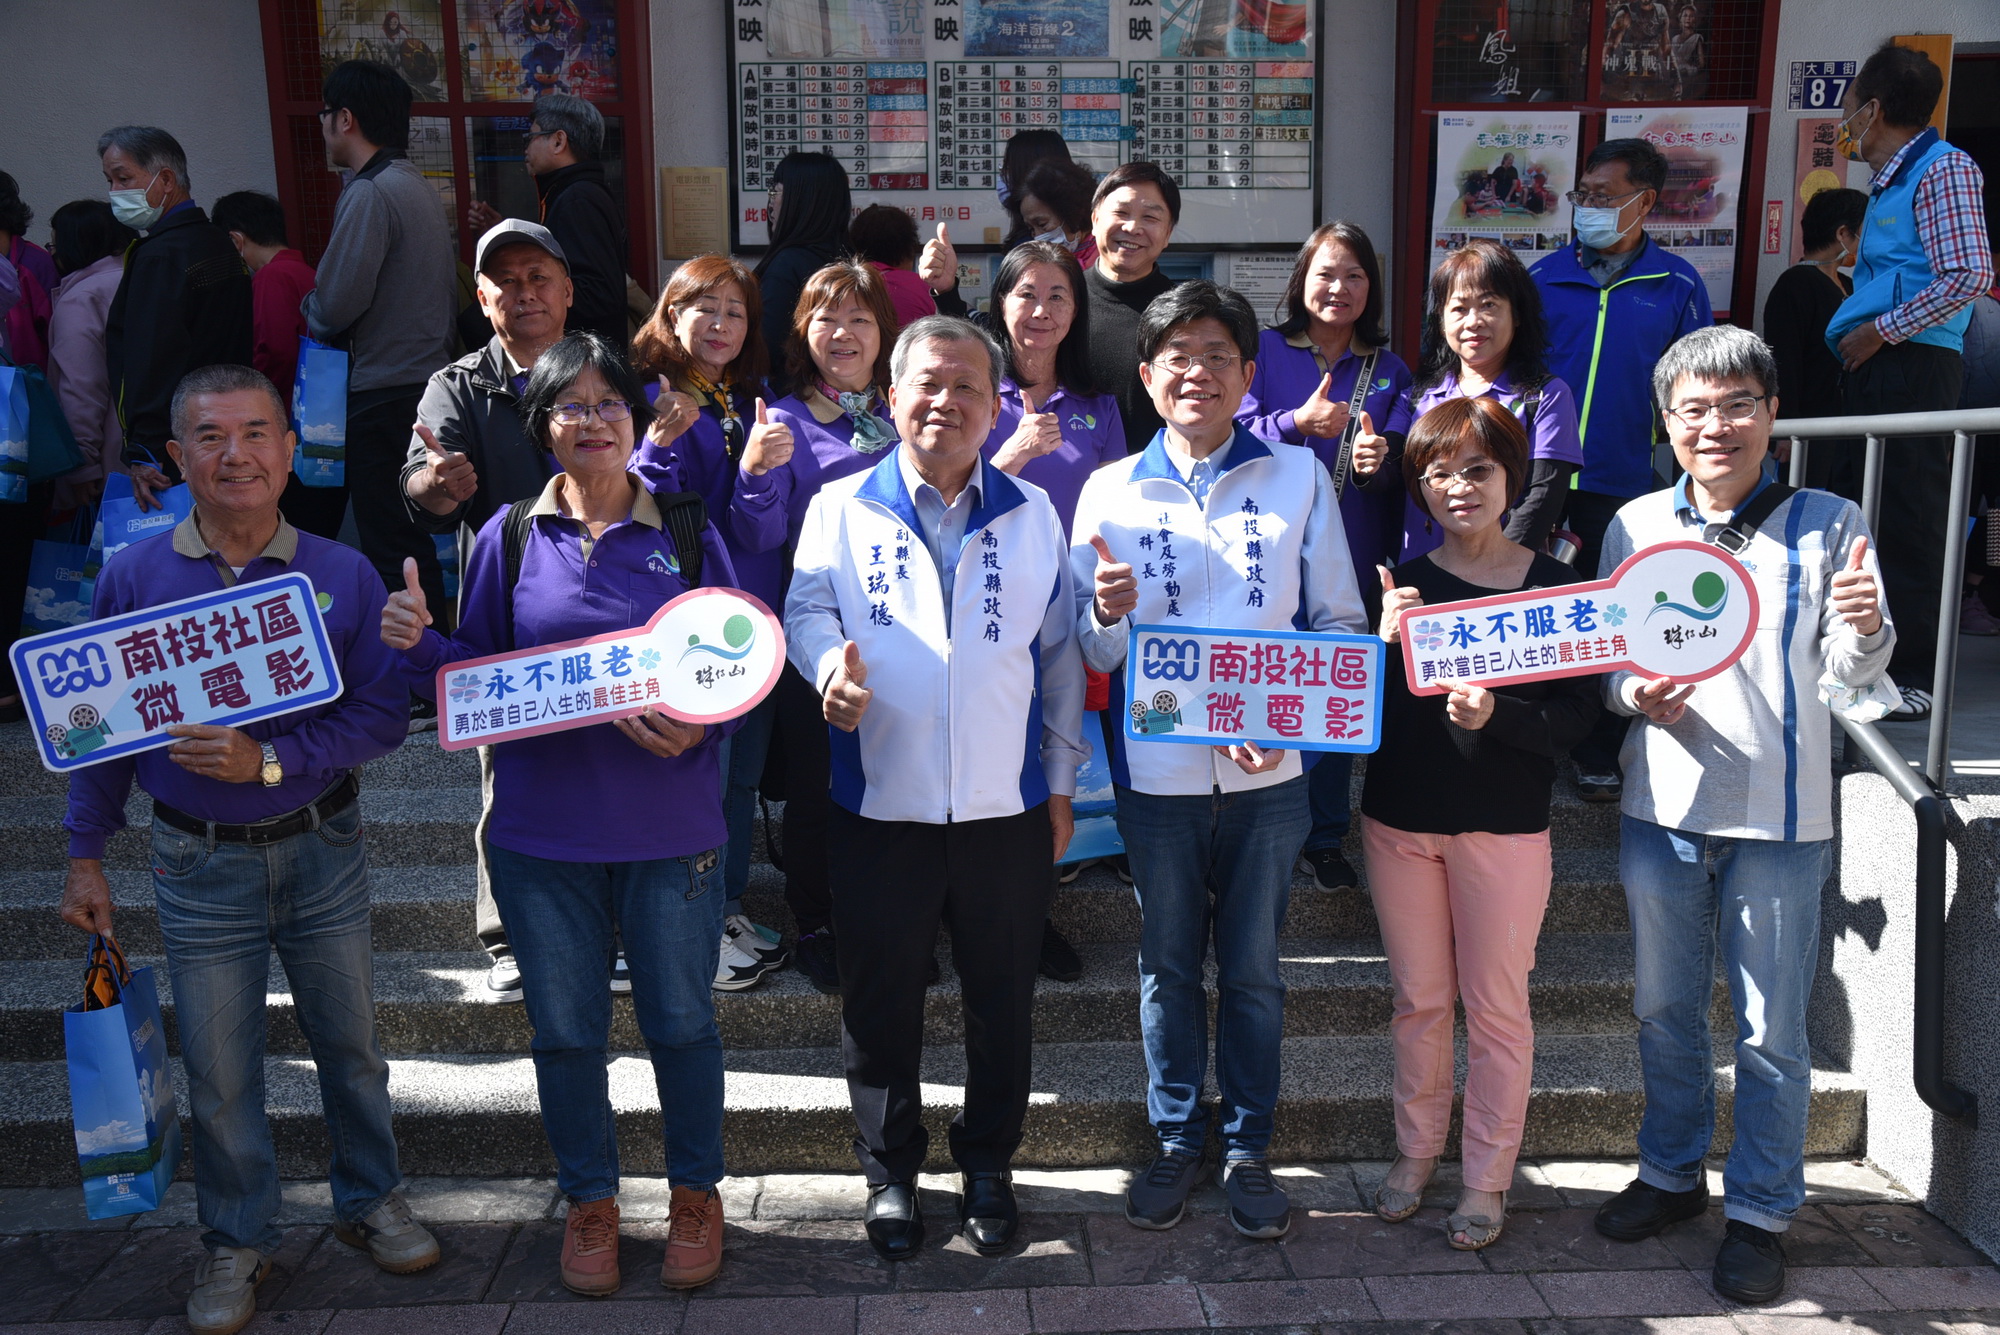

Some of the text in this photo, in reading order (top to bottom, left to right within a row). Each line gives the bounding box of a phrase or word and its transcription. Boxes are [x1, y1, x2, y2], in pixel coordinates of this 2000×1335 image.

[1015, 65, 1026, 76] 點
[1046, 65, 1058, 76] 分
[1791, 62, 1802, 85] 南投市
[1805, 62, 1855, 75] 大同街
[762, 82, 797, 93] 第二場
[958, 81, 992, 92] 第二場
[1151, 81, 1184, 92] 第二場
[1810, 78, 1847, 107] 87
[763, 98, 797, 109] 第三場
[958, 97, 992, 108] 第三場
[1151, 97, 1184, 108] 第三場
[763, 114, 798, 125] 第四場
[958, 113, 992, 124] 第四場
[1151, 113, 1184, 124] 第四場
[764, 130, 798, 141] 第五場
[958, 129, 992, 140] 第五場
[1151, 129, 1184, 140] 第五場
[854, 145, 865, 156] 分
[958, 145, 992, 155] 第六場
[1151, 145, 1250, 155] 第六場 點 分
[855, 162, 865, 172] 分
[959, 160, 993, 171] 第七場
[1207, 160, 1218, 171] 點
[1239, 160, 1250, 171] 分
[855, 177, 865, 188] 分
[1207, 176, 1218, 186] 點
[1239, 176, 1250, 186] 分
[894, 528, 910, 580] 副縣長
[1138, 534, 1158, 579] 科長
[1241, 497, 1266, 608] 南投縣政府
[1156, 512, 1183, 617] 社會及勞動處
[867, 544, 893, 626] 王瑞德
[980, 528, 1003, 643] 南投縣政府
[1448, 598, 1599, 650] 永不服老
[115, 592, 303, 681] 南投社區
[1420, 633, 1629, 682] 勇於當自己人生的最佳主角
[1209, 641, 1369, 690] 南投社區
[483, 645, 635, 701] 永不服老
[454, 677, 661, 736] 勇於當自己人生的最佳主角
